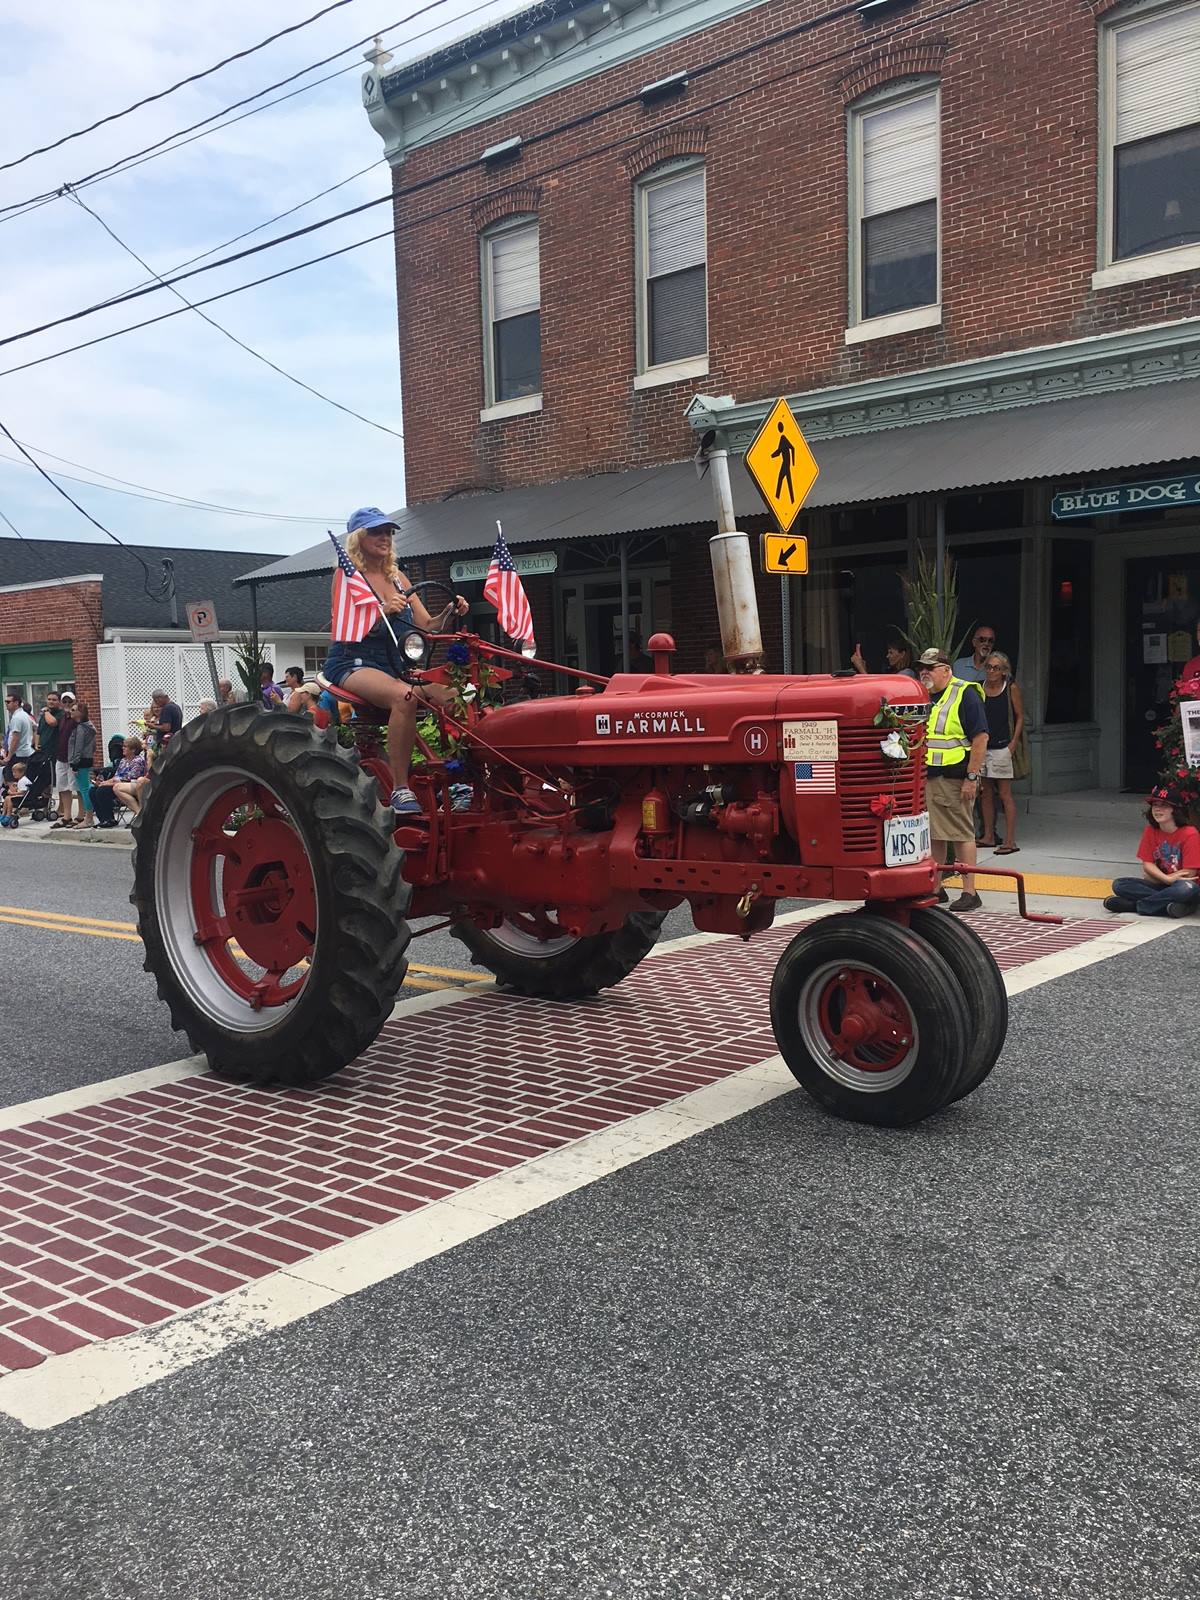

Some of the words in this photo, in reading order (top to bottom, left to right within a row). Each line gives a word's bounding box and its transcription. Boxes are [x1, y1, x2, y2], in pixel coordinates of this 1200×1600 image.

[1060, 490, 1120, 511] BLUE
[1127, 482, 1186, 503] DOG
[522, 558, 552, 571] REALTY
[615, 718, 705, 734] FARMALL
[751, 733, 762, 749] H
[892, 833, 915, 856] MRS
